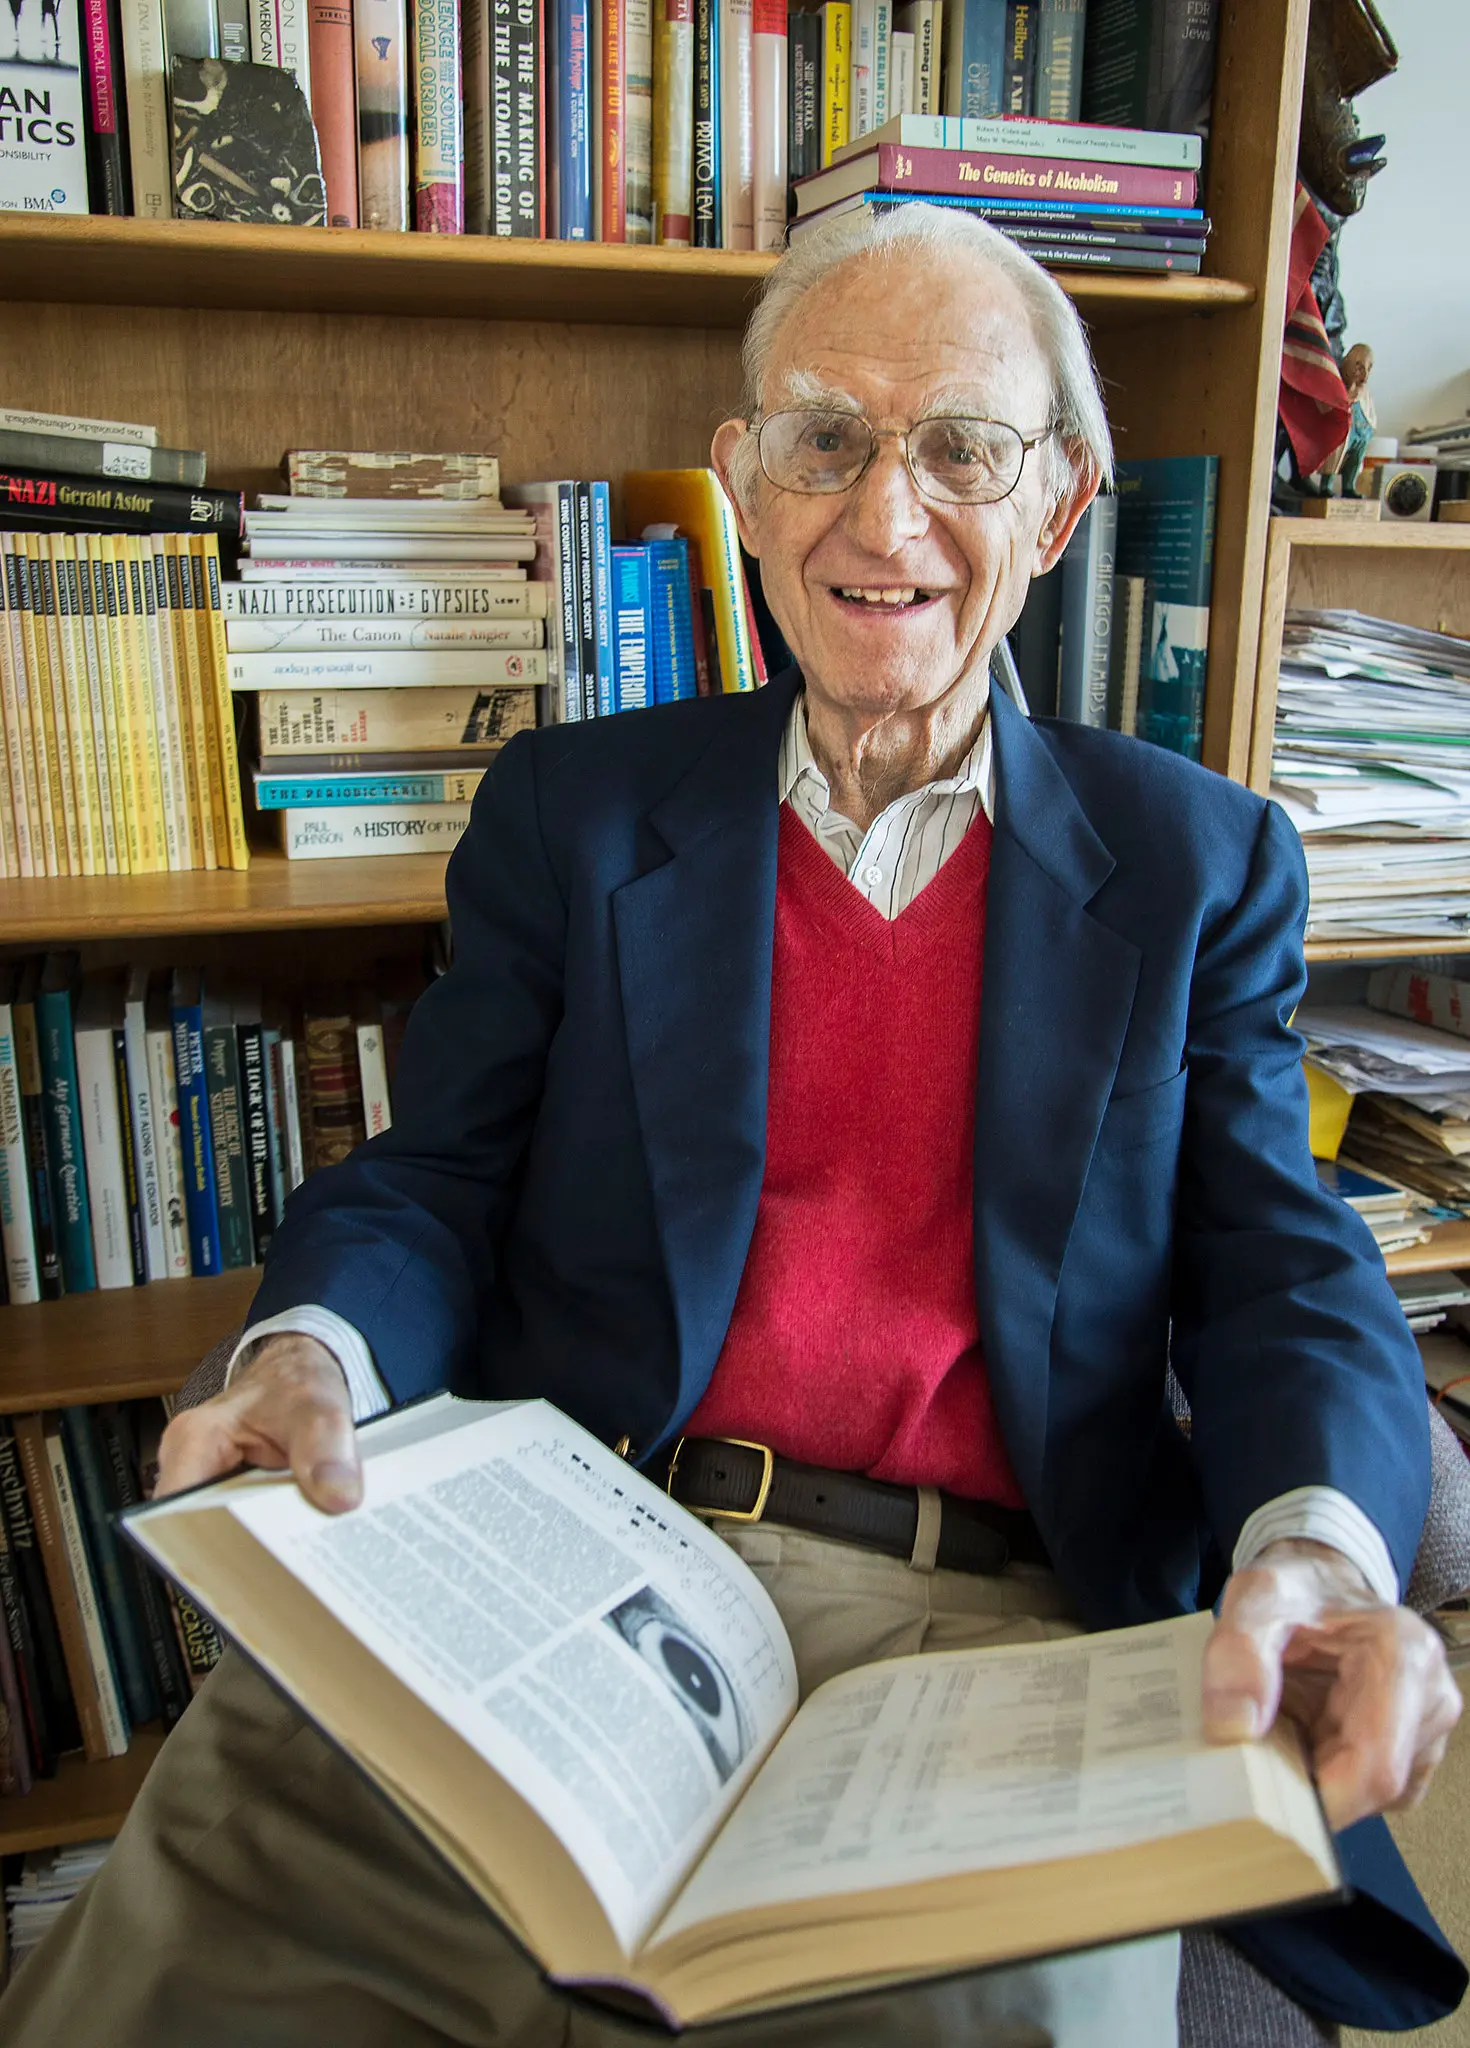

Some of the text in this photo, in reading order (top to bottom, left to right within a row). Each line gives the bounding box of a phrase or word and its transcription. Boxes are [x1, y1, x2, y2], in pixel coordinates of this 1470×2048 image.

[223, 22, 244, 43] Our
[1014, 4, 1030, 60] Heilbut
[1182, 26, 1211, 42] Jews
[91, 0, 110, 128] BIOMEDICAL POLITICS
[607, 8, 621, 118] SOME LIKE IT HOT
[876, 6, 887, 109] FROM BERLIN TO
[921, 19, 931, 98] auf Deutsch
[421, 66, 438, 147] ORDER
[440, 85, 457, 165] SOVIET
[494, 24, 512, 237] THE ATOMIC BOMB
[517, 41, 534, 220] THE MAKING OF
[695, 120, 713, 220] PRIMO LEVI
[958, 161, 1119, 194] The Genetics of Alcoholism
[23, 196, 54, 211] BMA
[1029, 228, 1038, 237] the
[1038, 229, 1059, 239] Internet
[1071, 232, 1088, 242] Public
[1088, 234, 1116, 243] Commons
[1063, 252, 1081, 260] Future
[1082, 252, 1088, 261] of
[1088, 253, 1110, 262] America
[8, 477, 154, 513] NAZI Gerald Astor
[594, 497, 604, 524] KING
[560, 498, 573, 643] KING COUNTY MEDICAL SOCIETY
[596, 525, 606, 566] COUNTY
[208, 556, 221, 610] PERSPECTIVES
[239, 588, 277, 614] NAZI
[285, 588, 395, 614] PERSECUTION
[421, 588, 490, 614] GYPSIES
[580, 495, 594, 697] KING COUNTY MEDICAL SOCIETY 2012
[597, 567, 607, 608] MEDICAL
[317, 627, 511, 644] The Canon Natalie Angier
[598, 609, 608, 648] SOCIETY
[1089, 552, 1113, 714] CHICAGO IN MAPS
[617, 607, 647, 710] THE EMPEROR
[737, 668, 748, 690] Wir
[269, 784, 429, 800] THE PERIODIC TABLE
[294, 832, 344, 849] JOHNSON
[304, 820, 331, 833] PAUL
[353, 820, 443, 838] A HISTORY OF
[174, 1020, 193, 1087] MEDAWAR
[188, 1029, 205, 1076] PETER
[209, 1038, 227, 1078] Popper
[243, 1034, 269, 1163] THE LOGIC OF LIFE
[224, 1109, 240, 1141] LOGIC
[229, 1142, 241, 1158] OF
[48, 1077, 82, 1225] My German Question
[140, 1121, 160, 1228] ALONG THE EQUATOR
[214, 1149, 234, 1209] DISCOVERY
[0, 1436, 34, 1549] Auschwitz
[35, 1492, 54, 1547] UNIVERSITY
